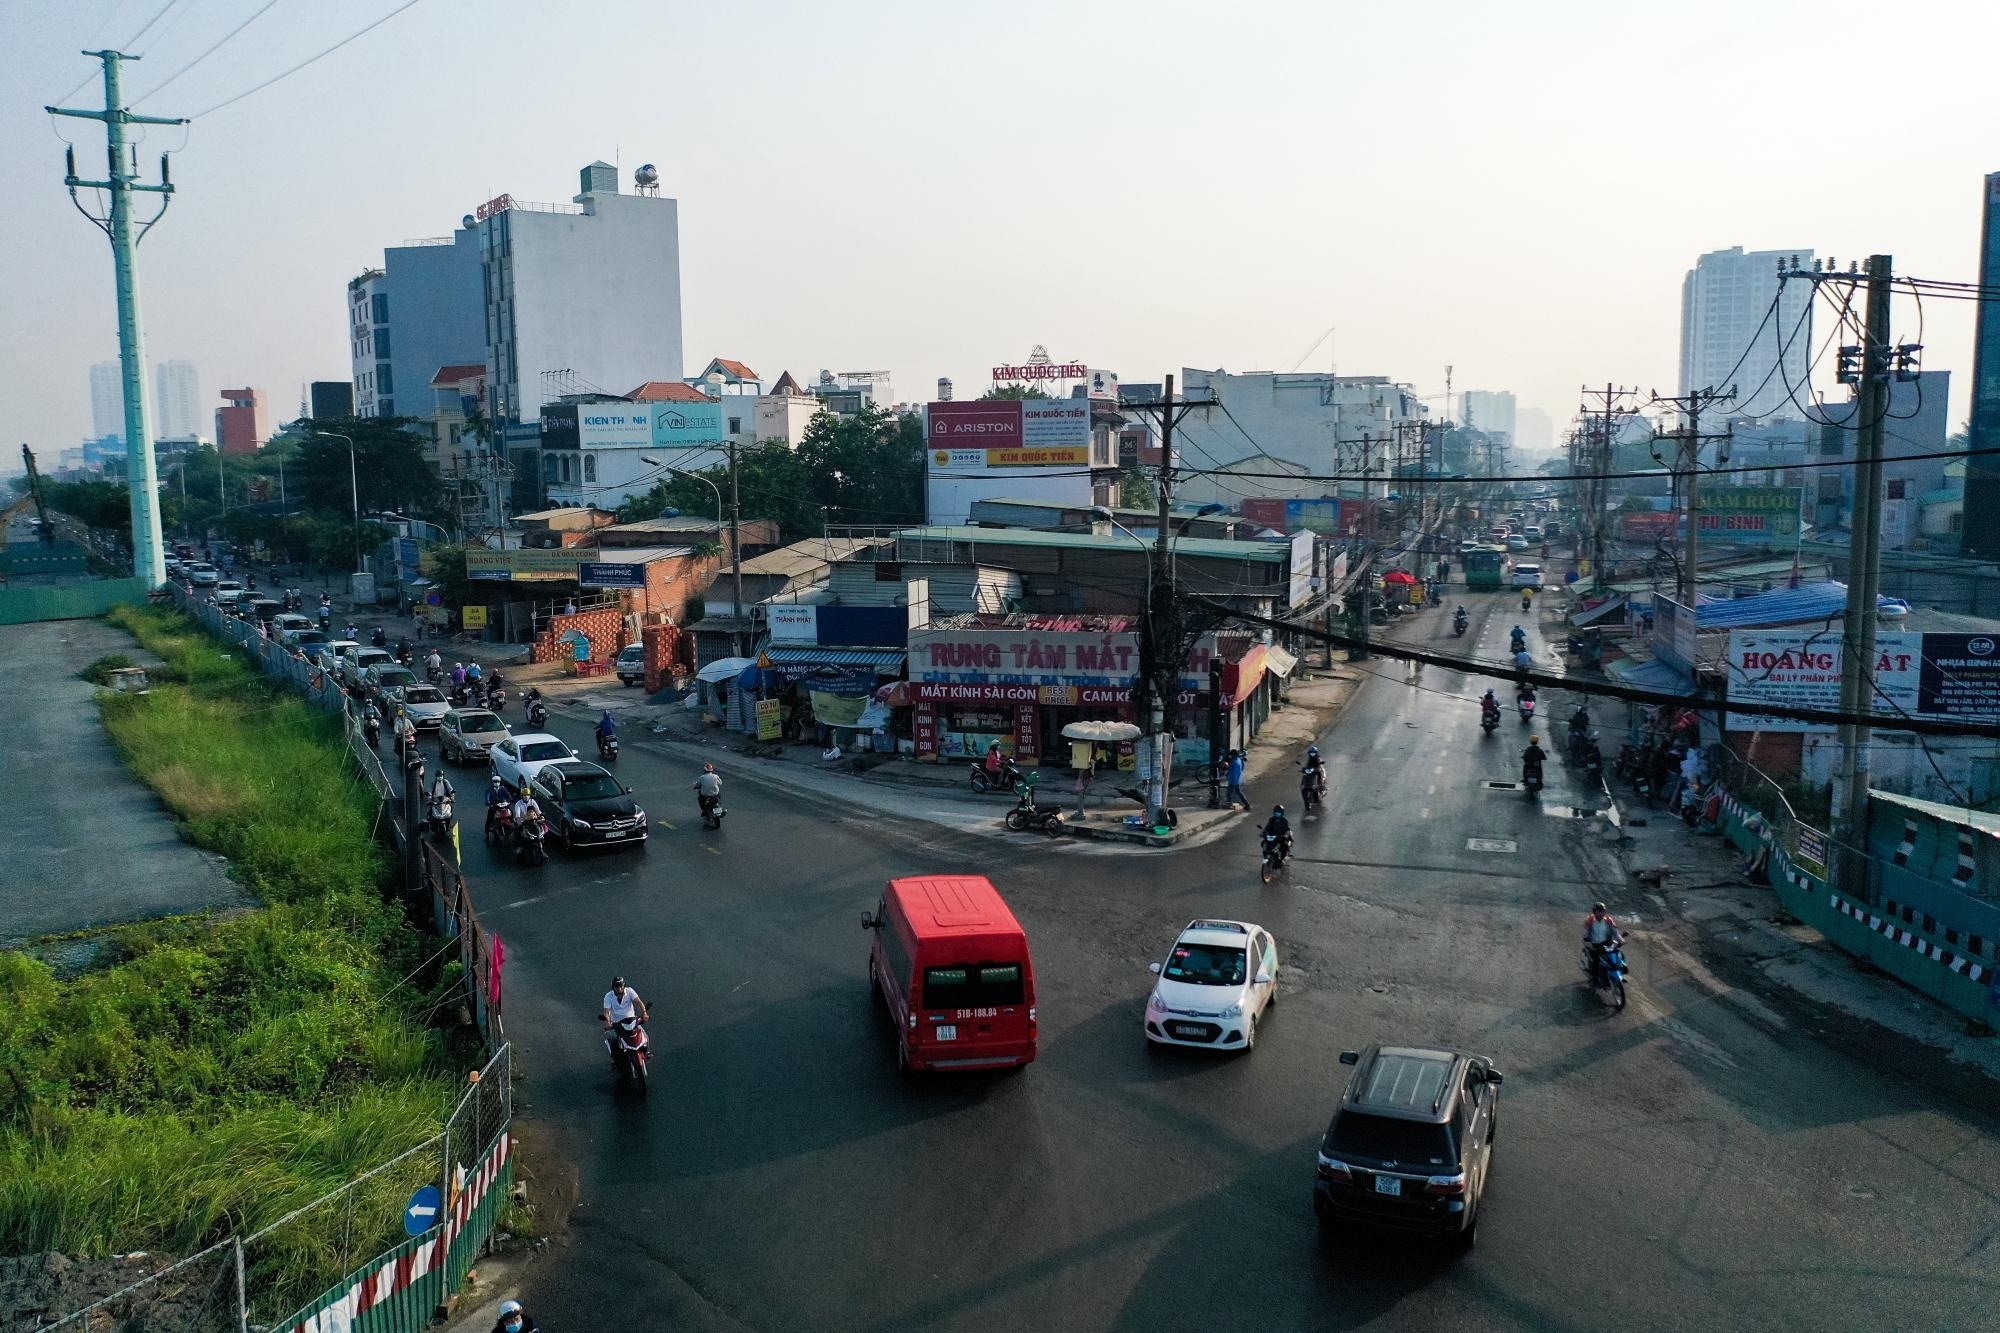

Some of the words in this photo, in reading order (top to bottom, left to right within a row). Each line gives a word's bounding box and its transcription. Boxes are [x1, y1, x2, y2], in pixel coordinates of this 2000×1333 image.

[993, 367, 1015, 380] KIM
[1025, 409, 1040, 418] KIM
[1042, 408, 1065, 418] QUỐC
[1066, 406, 1085, 417] TIẾN
[685, 417, 717, 426] ESTATE
[953, 423, 1014, 433] ARISTON
[1001, 452, 1019, 461] KIM
[1009, 638, 1066, 669] TÂM
[1075, 634, 1133, 670] MẮT
[950, 683, 980, 698] KÍNH
[984, 684, 1004, 699] SÀI
[1007, 686, 1036, 700] GÒN
[1045, 686, 1069, 695] BEST
[1045, 695, 1071, 704] PRICE
[1082, 690, 1112, 702] CAM
[1019, 705, 1033, 713] CAM
[1021, 725, 1032, 733] GIÁ
[1021, 735, 1033, 744] TỐT
